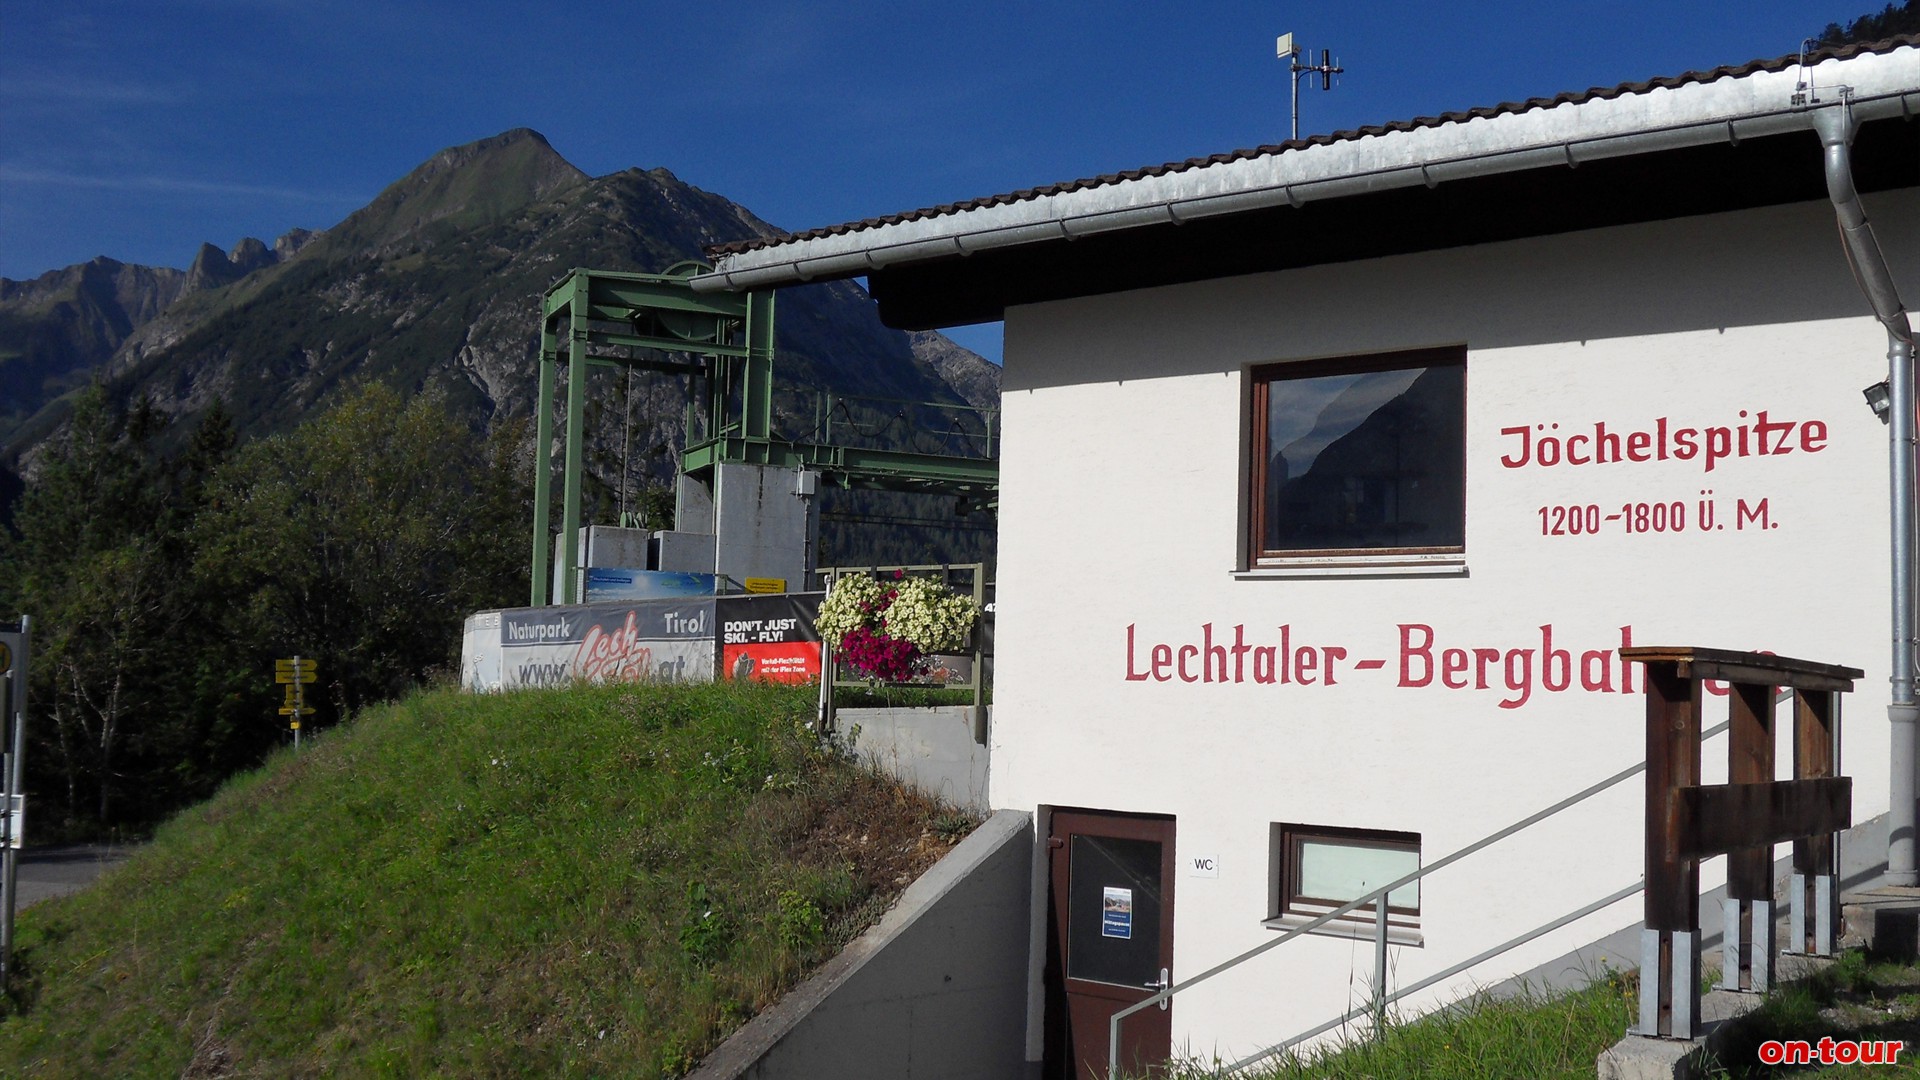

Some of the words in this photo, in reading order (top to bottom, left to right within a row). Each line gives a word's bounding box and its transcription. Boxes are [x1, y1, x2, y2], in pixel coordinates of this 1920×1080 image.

[1500, 410, 1828, 473] Jöchelspitze
[1538, 501, 1685, 536] 1200-1800
[1699, 489, 1724, 532] Ü.
[1736, 497, 1779, 531] M.
[508, 616, 570, 642] Naturpark
[664, 610, 704, 634] Tirol
[724, 620, 763, 632] DON'T
[764, 618, 797, 631] JUST
[723, 632, 749, 643] SKI.
[758, 631, 784, 642] FLY!
[1194, 858, 1213, 871] WC
